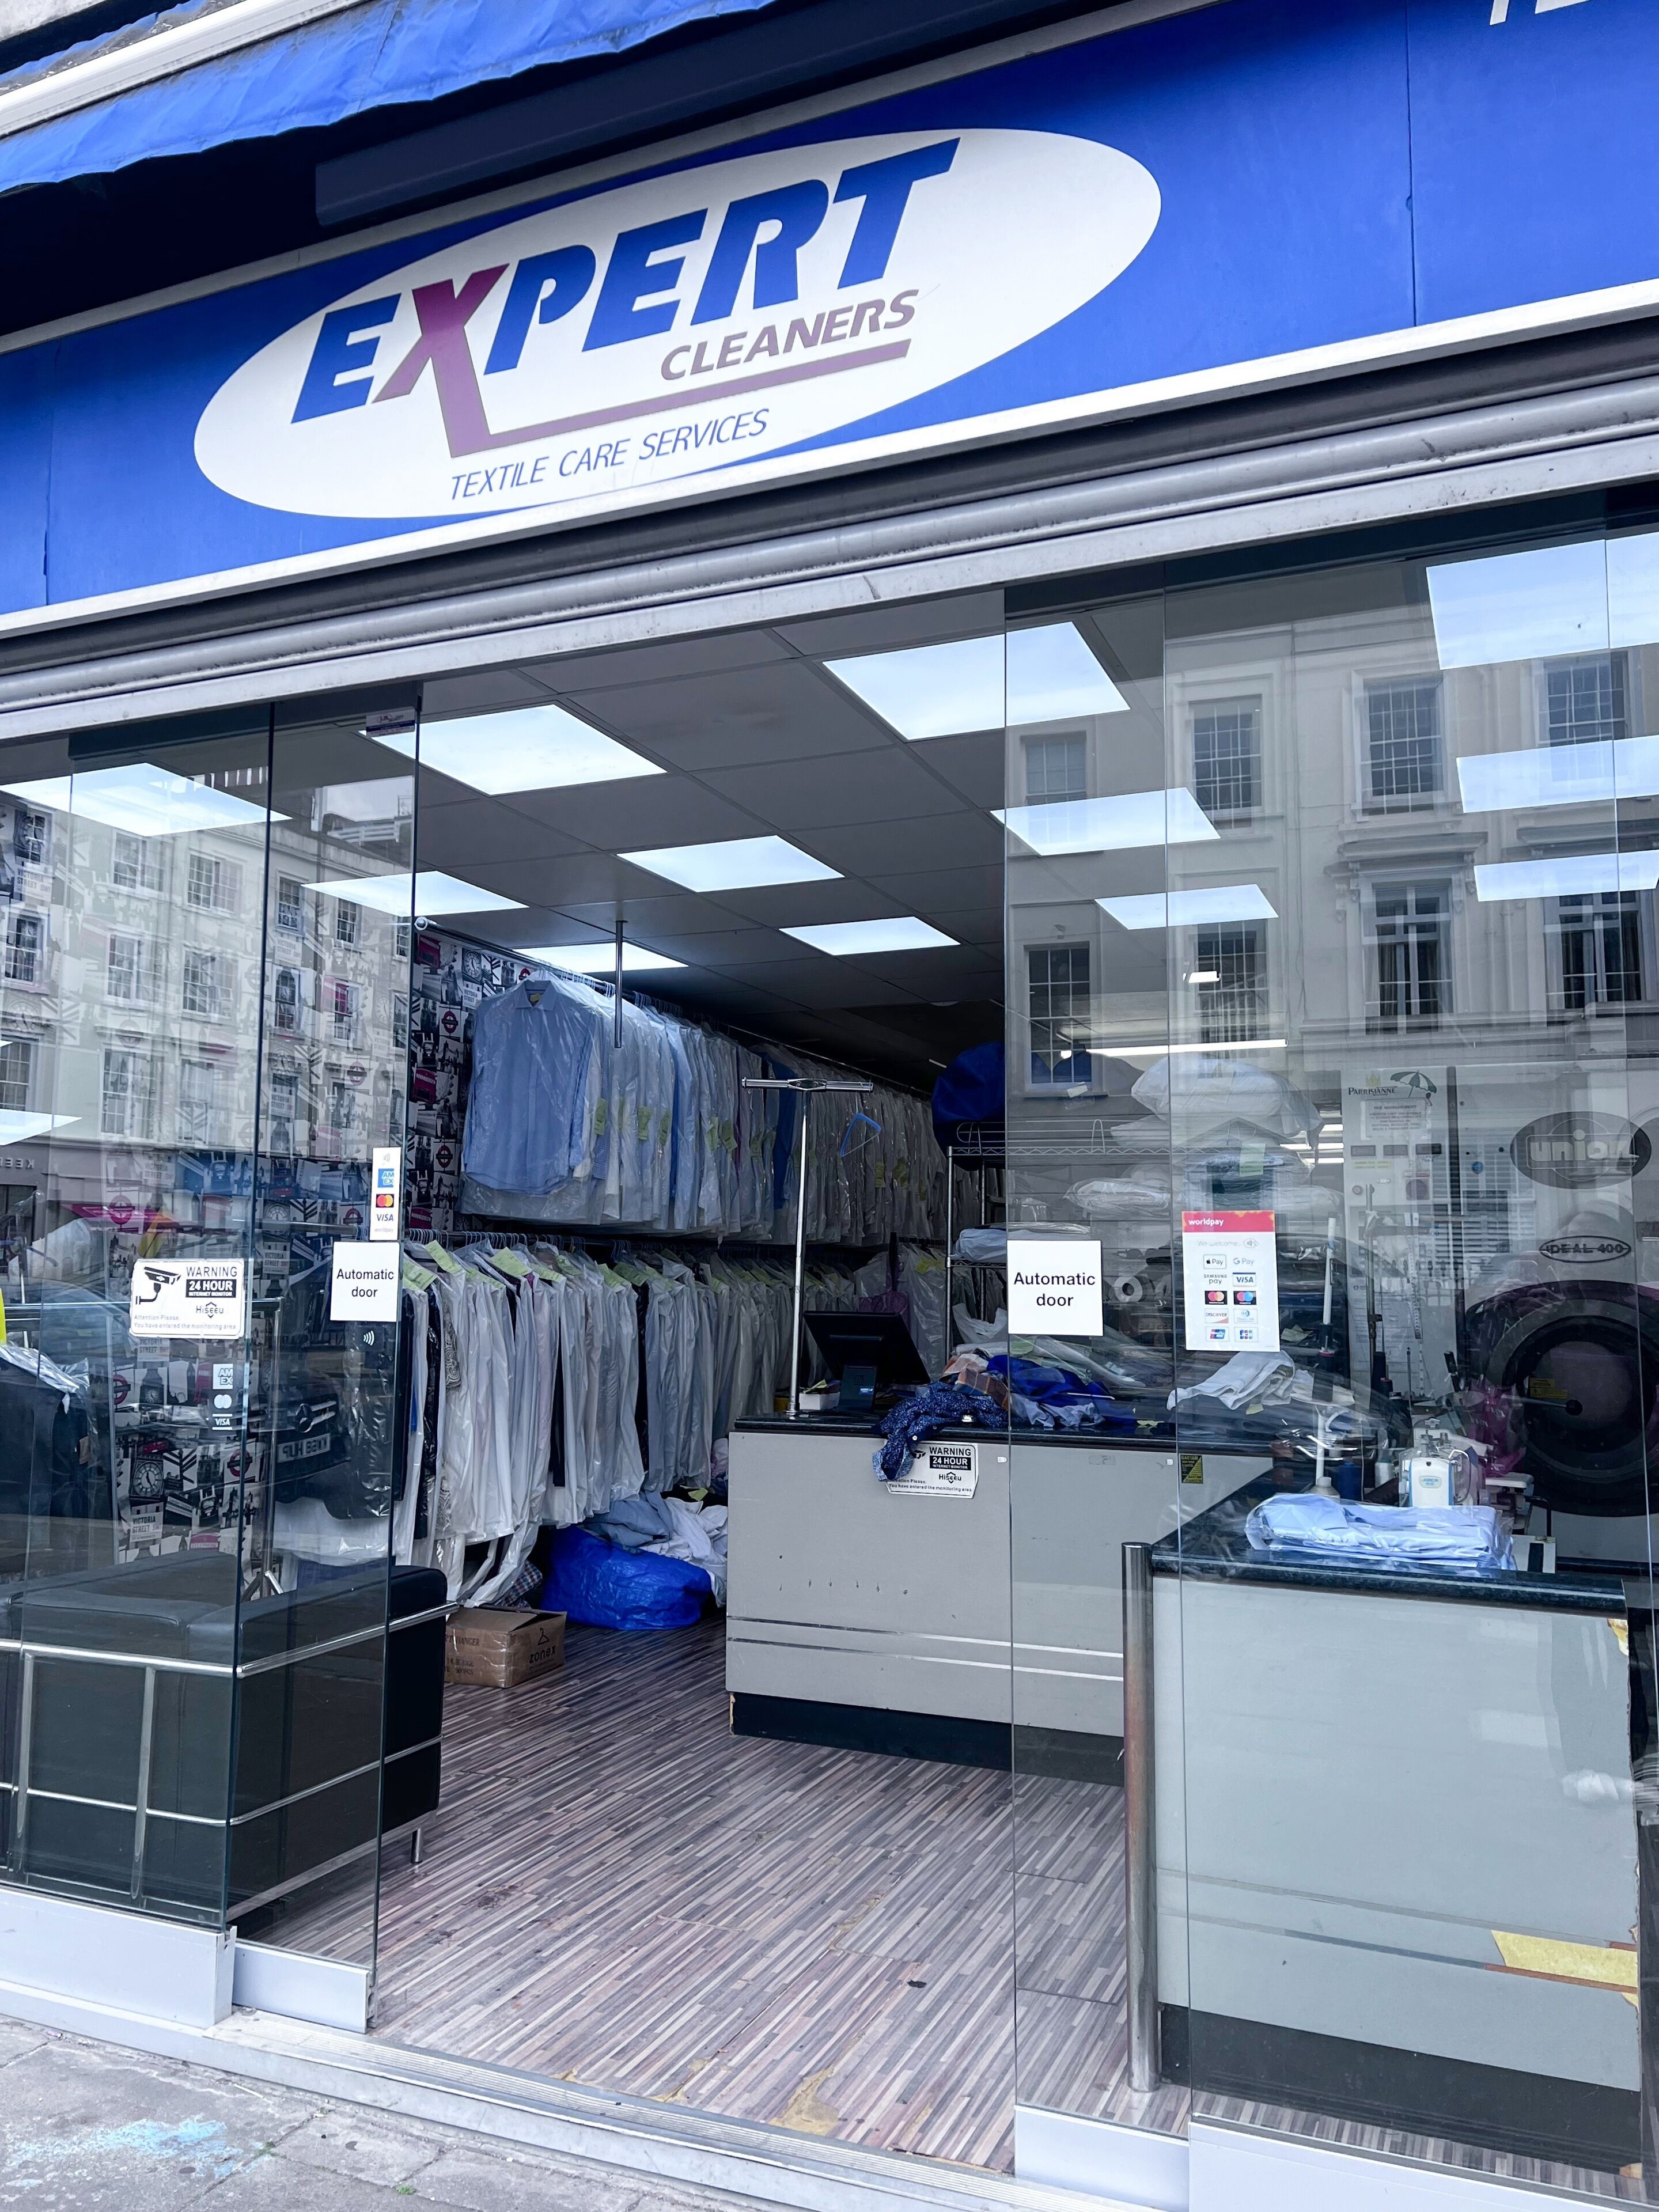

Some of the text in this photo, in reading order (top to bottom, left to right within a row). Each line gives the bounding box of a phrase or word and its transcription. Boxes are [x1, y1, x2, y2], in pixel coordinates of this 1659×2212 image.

[291, 137, 961, 458] EXPERT
[661, 289, 919, 380] CLEANERS
[450, 408, 769, 499] TEXTILE CARE SERVICES
[1189, 1218, 1224, 1226] worldpay
[1546, 1244, 1623, 1253] IDEAL 400
[186, 1266, 237, 1277] WARNING
[336, 1268, 395, 1280] Automatic
[1014, 1271, 1096, 1286] Automatic
[189, 1281, 233, 1291] 24 HOUR
[351, 1286, 378, 1297] door
[1036, 1293, 1074, 1306] door
[214, 1418, 230, 1426] VISA
[929, 1446, 971, 1456] WARNING
[932, 1456, 968, 1465] 24 HOUR
[132, 1516, 156, 1525] VICTORIA
[132, 1525, 150, 1533] STREET
[455, 1636, 480, 1646] HANGER
[529, 1645, 556, 1664] zonex
